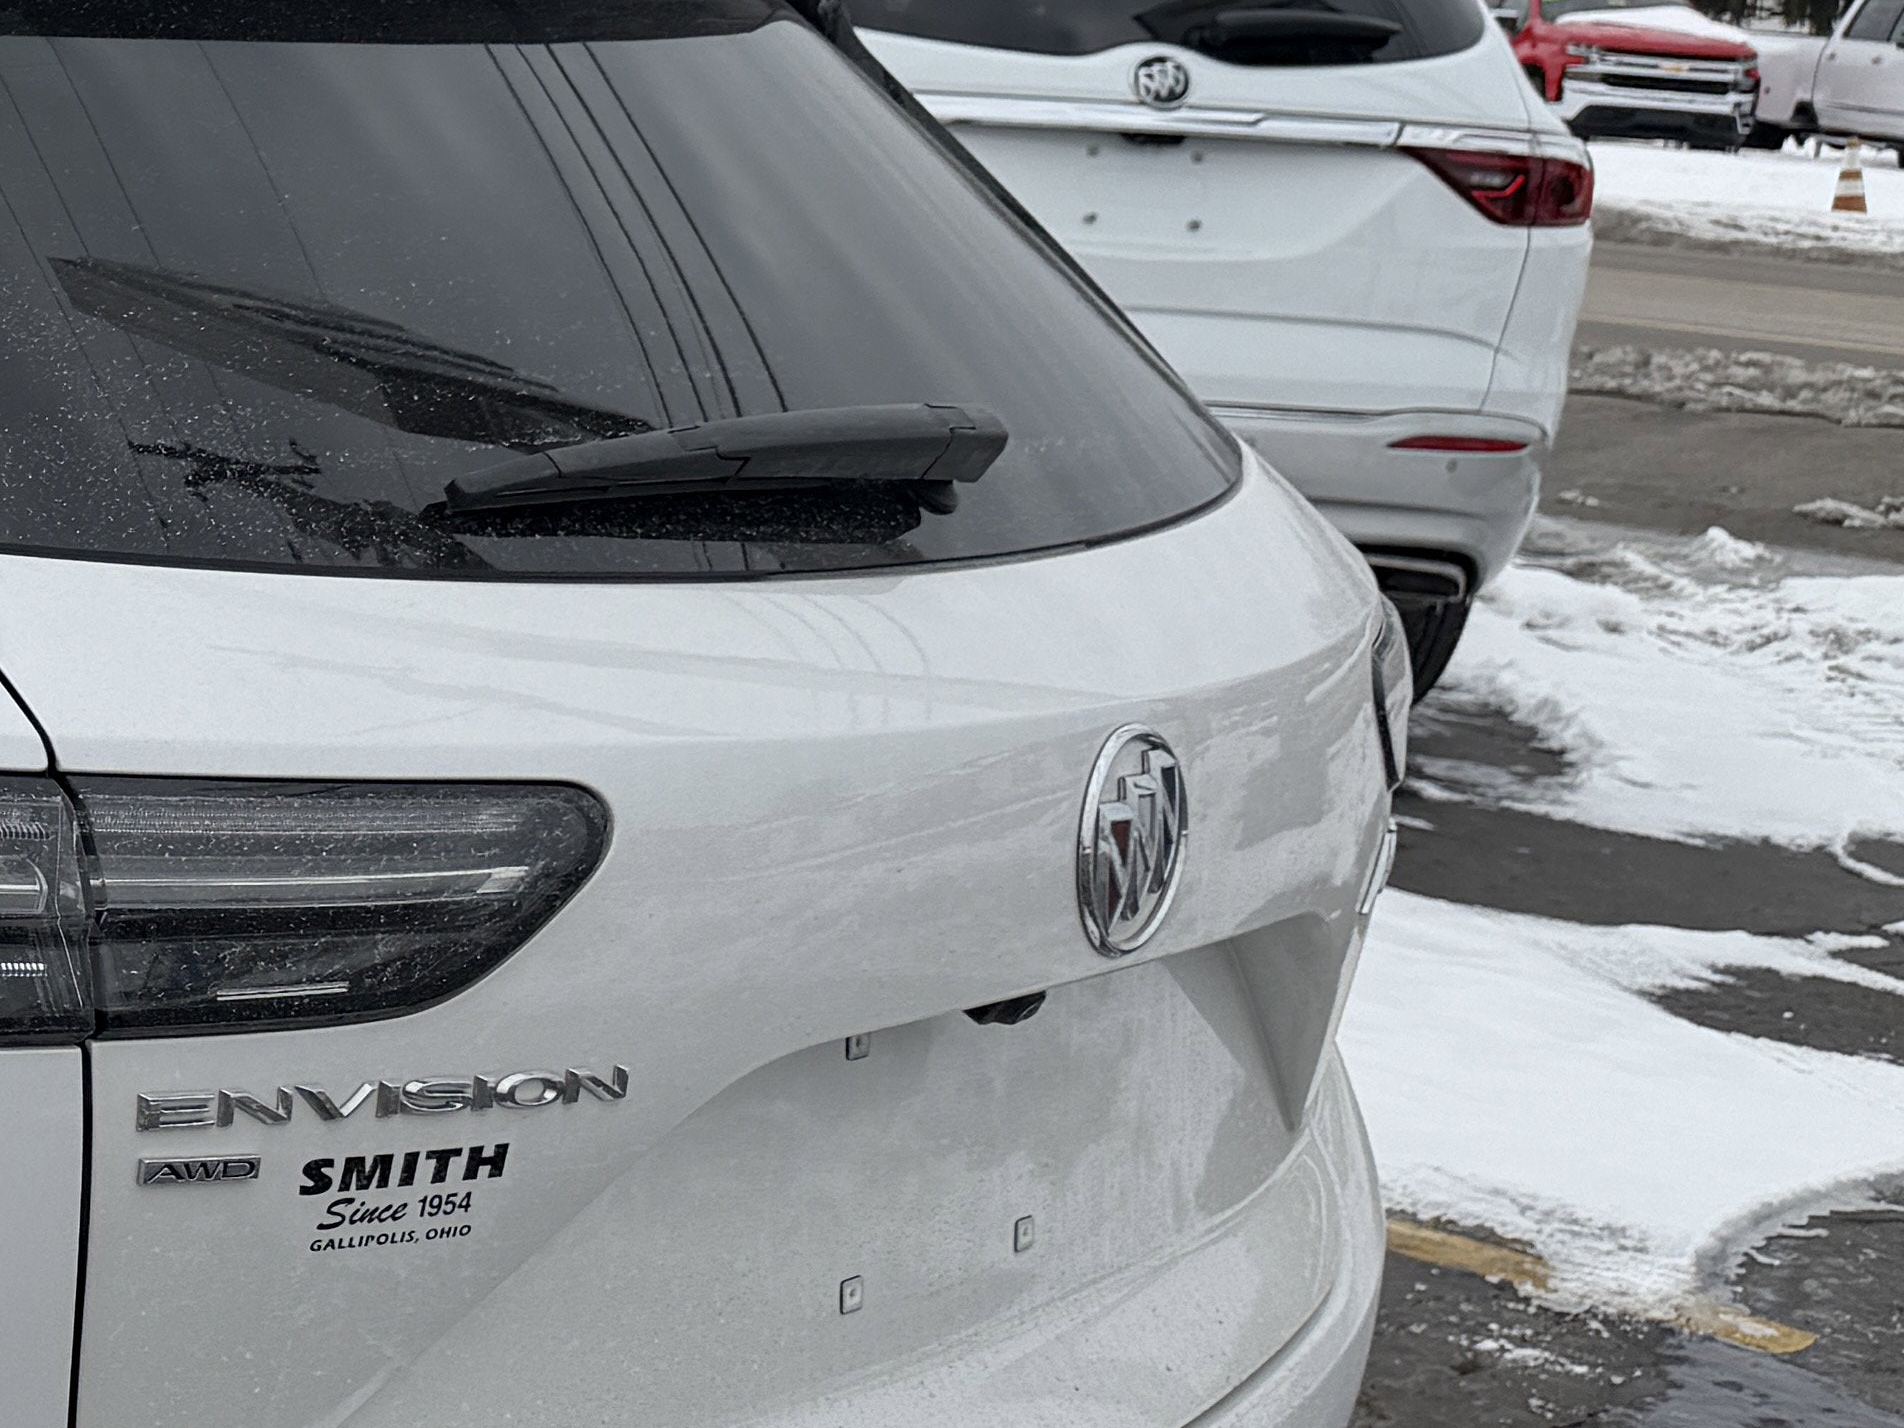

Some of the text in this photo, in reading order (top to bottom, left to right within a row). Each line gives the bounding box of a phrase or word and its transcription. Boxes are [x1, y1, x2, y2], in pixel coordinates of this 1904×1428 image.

[136, 1064, 629, 1133] ENVISION
[146, 1159, 256, 1183] AWD
[298, 1142, 511, 1196] SMITH
[316, 1190, 473, 1231] Since 1954
[425, 1224, 473, 1241] OHIO
